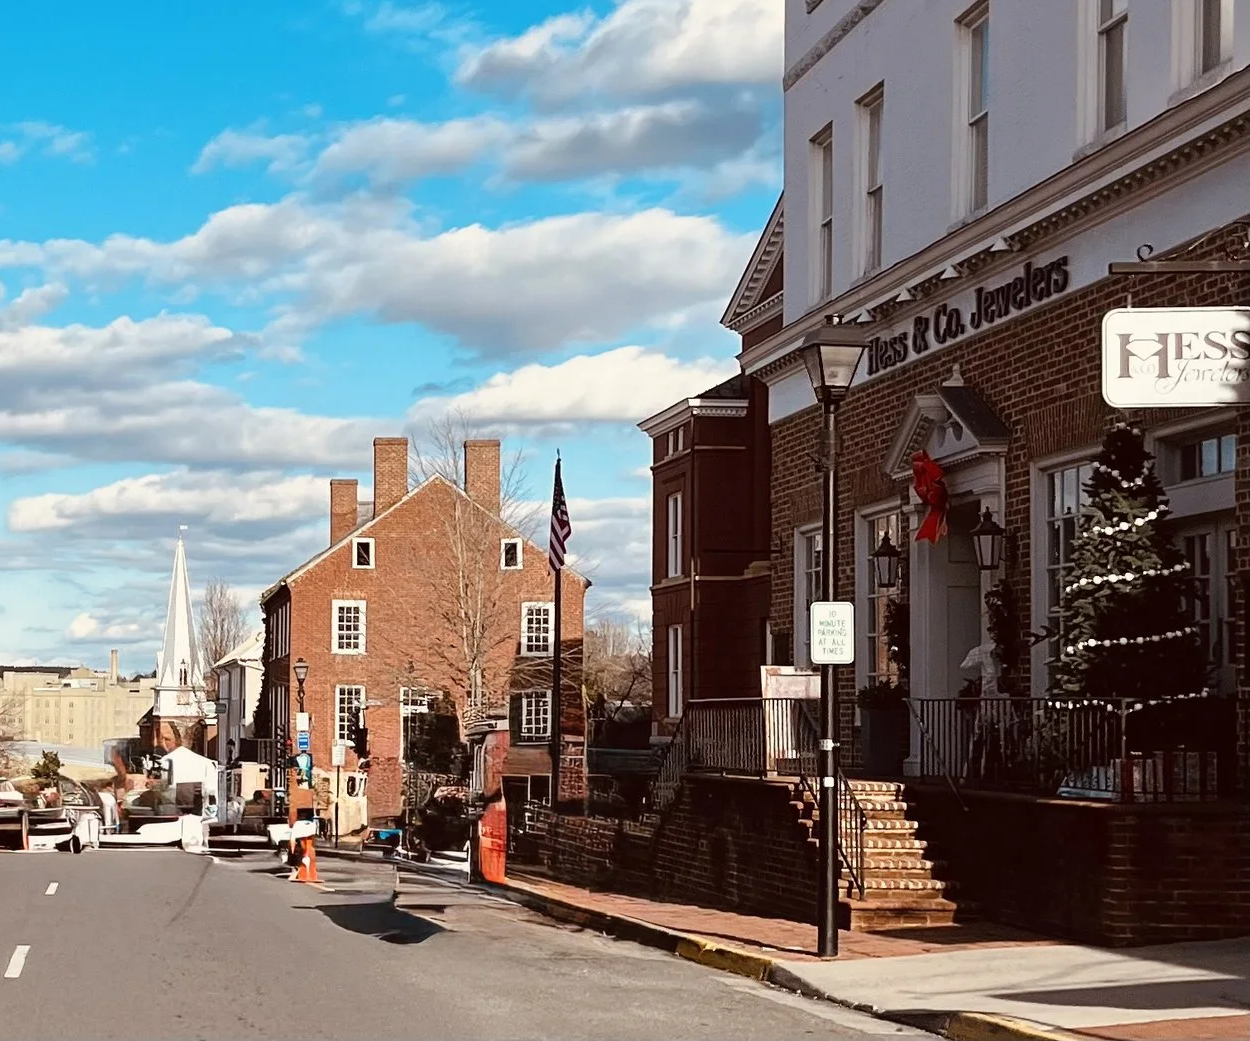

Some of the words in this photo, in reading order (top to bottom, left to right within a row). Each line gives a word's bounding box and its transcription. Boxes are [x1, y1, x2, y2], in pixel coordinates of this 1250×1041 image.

[867, 332, 908, 376] Hess
[911, 316, 929, 354] &
[933, 303, 965, 344] Co.
[969, 256, 1069, 329] Jewelers
[1116, 330, 1250, 378] HESS
[828, 610, 837, 618] 10
[818, 620, 846, 628] MINUTE
[817, 628, 847, 637] PARKING
[818, 638, 826, 646] AT
[831, 638, 846, 646] ALL
[822, 647, 844, 656] TIMES
